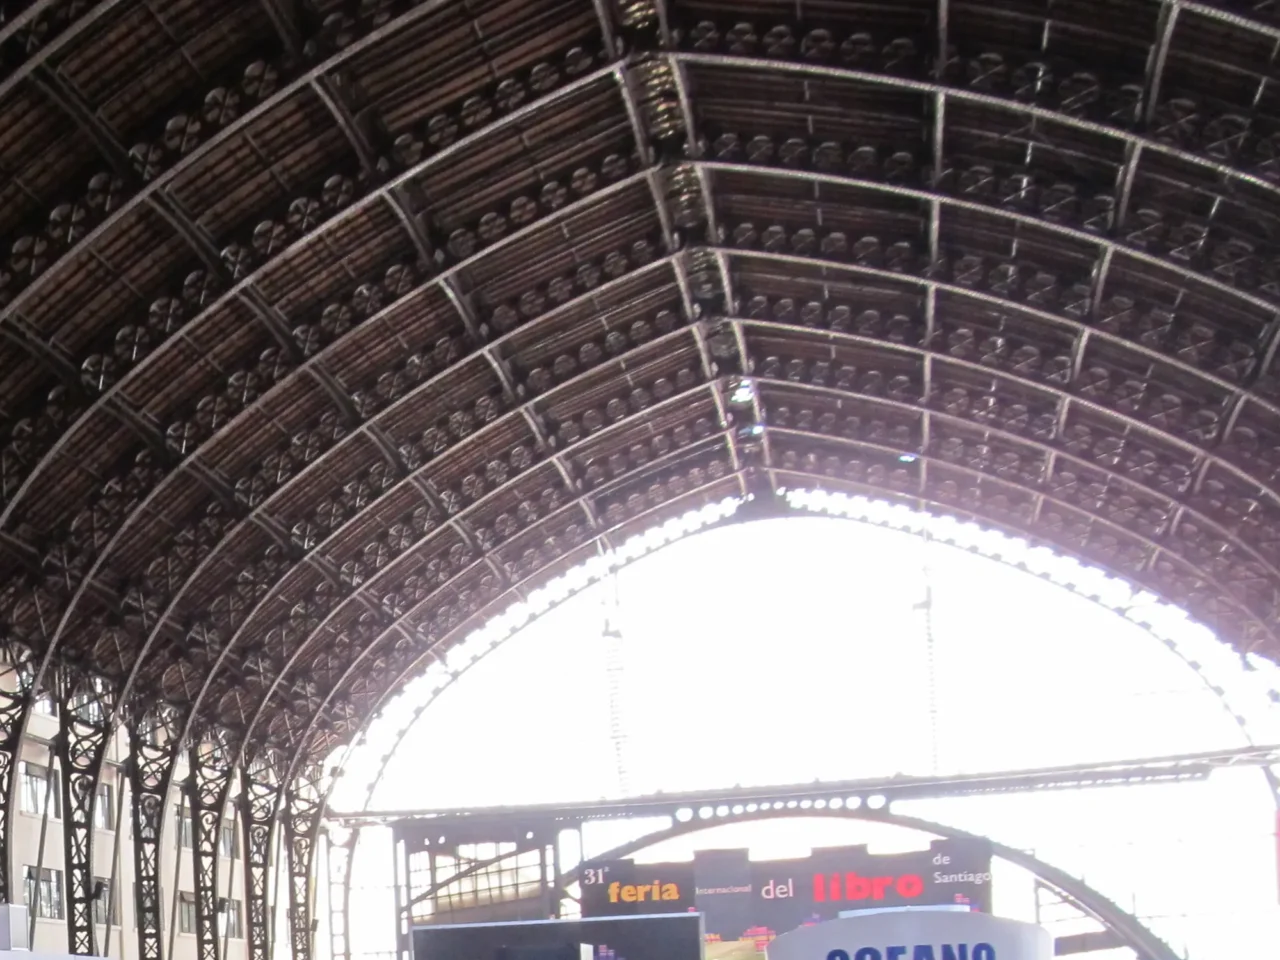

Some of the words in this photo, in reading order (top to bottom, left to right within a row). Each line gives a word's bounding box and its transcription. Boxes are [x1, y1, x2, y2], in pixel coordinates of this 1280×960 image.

[932, 853, 951, 865] de
[933, 871, 992, 885] Santiago
[608, 880, 680, 903] feria
[695, 884, 752, 895] Internacional
[761, 878, 794, 899] del
[813, 872, 925, 902] libro
